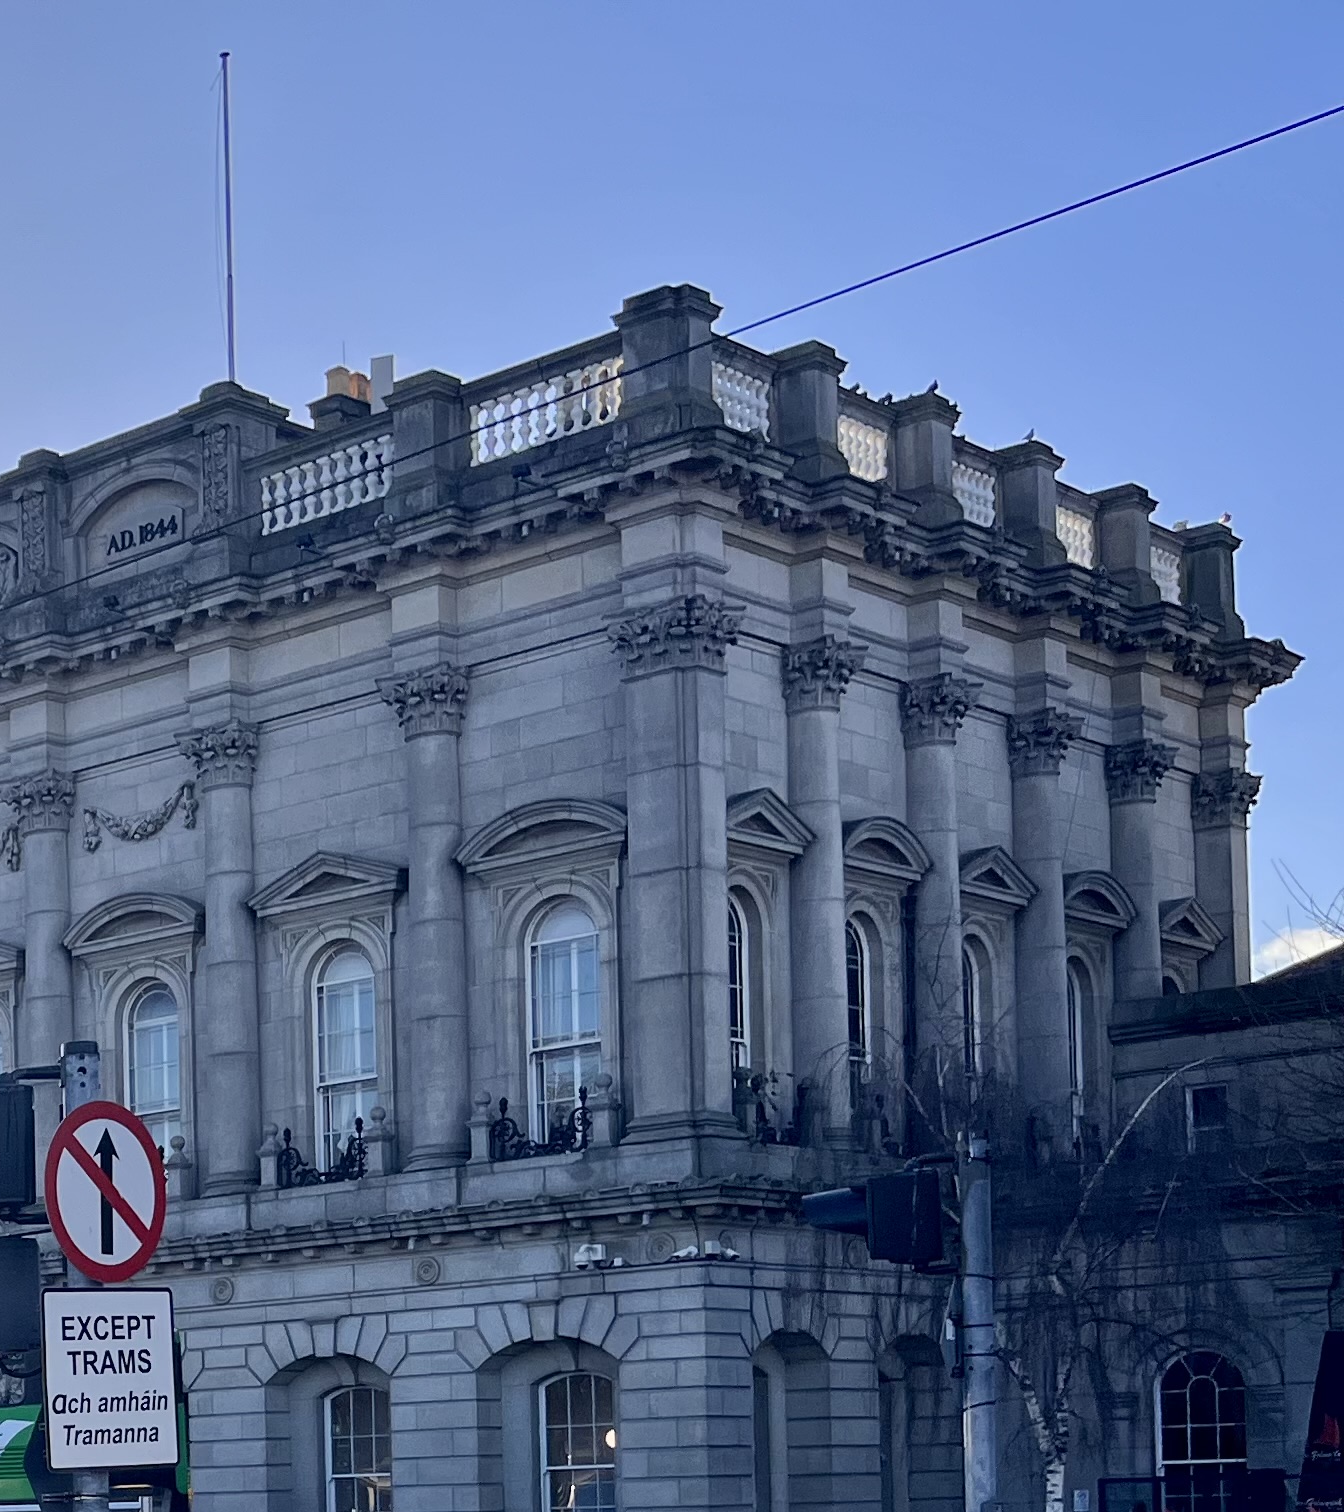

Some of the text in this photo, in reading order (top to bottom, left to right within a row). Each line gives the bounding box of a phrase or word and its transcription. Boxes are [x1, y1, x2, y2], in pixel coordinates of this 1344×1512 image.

[139, 515, 178, 545] 1844
[61, 1315, 156, 1341] EXCEPT
[66, 1349, 152, 1375] TRAMS
[98, 1389, 168, 1412] amháin
[63, 1424, 159, 1446] Tramanna
